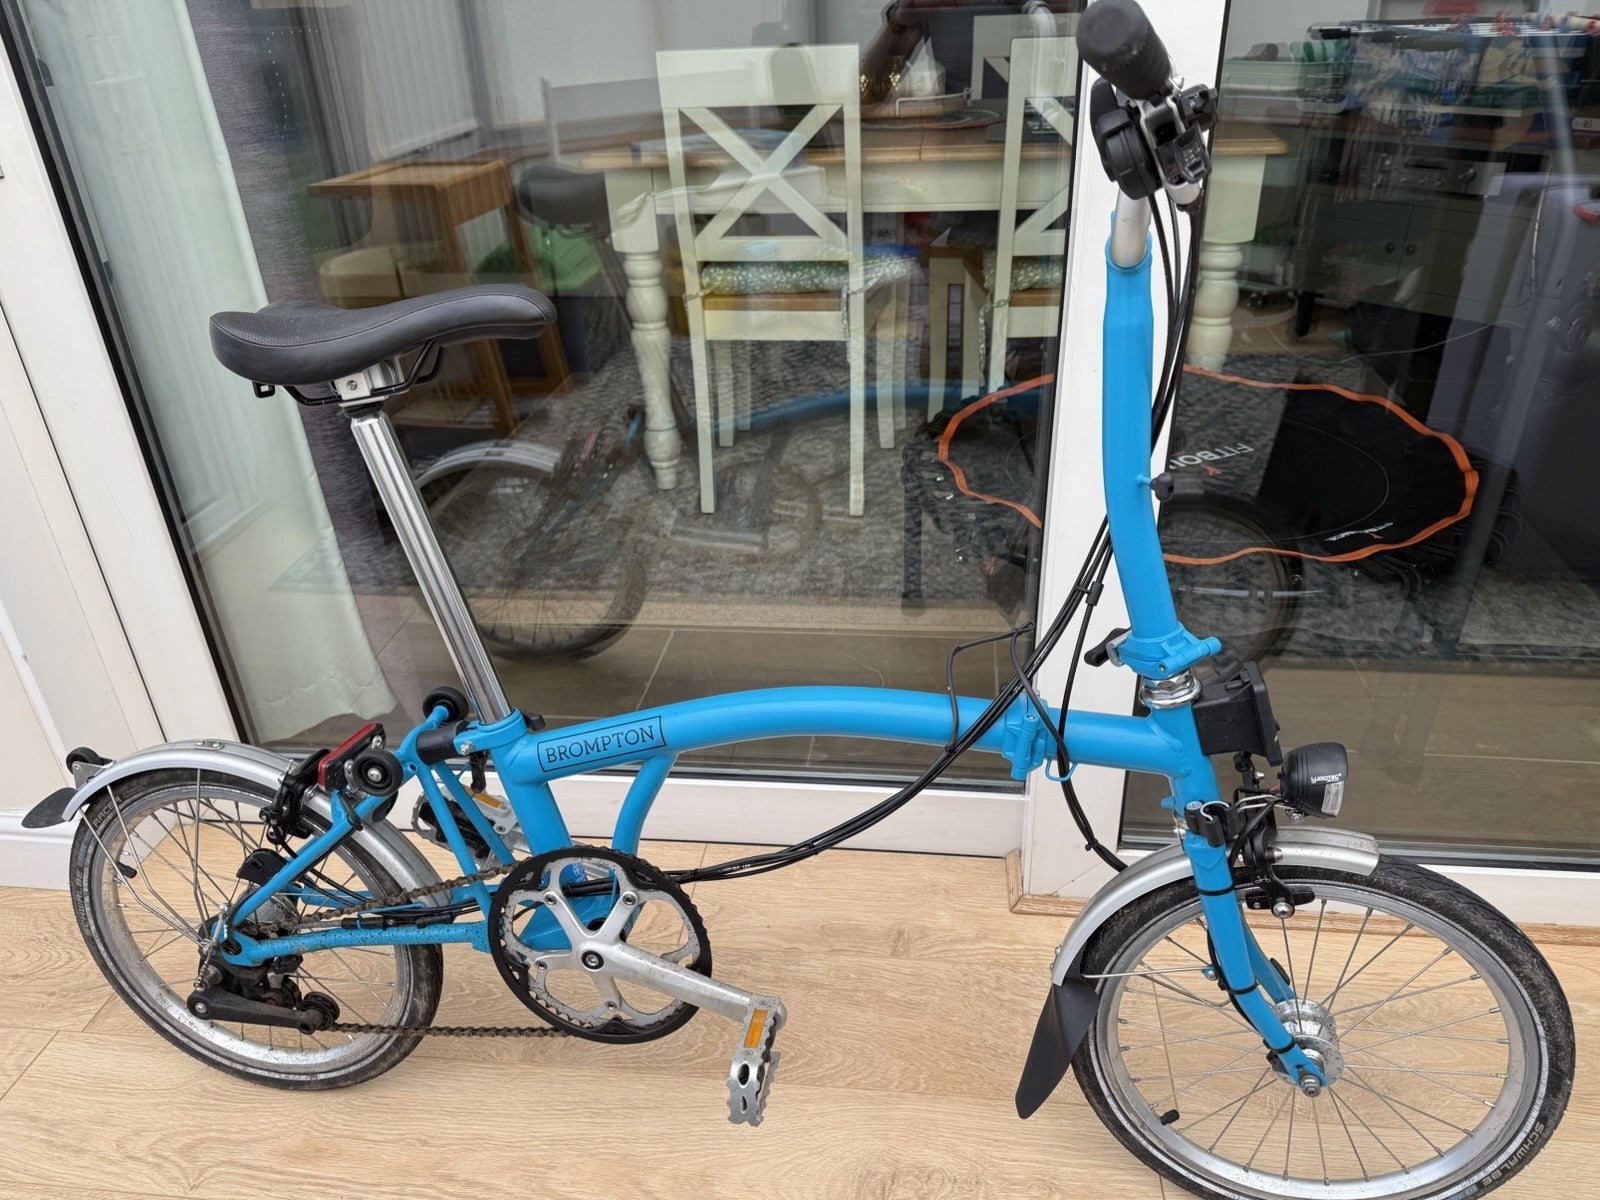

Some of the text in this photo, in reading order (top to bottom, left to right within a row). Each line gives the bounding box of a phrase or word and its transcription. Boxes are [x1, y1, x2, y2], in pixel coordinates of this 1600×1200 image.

[545, 725, 656, 763] BROMPTON
[92, 796, 122, 828] RACER
[1482, 1121, 1545, 1187] SCHWALBE
